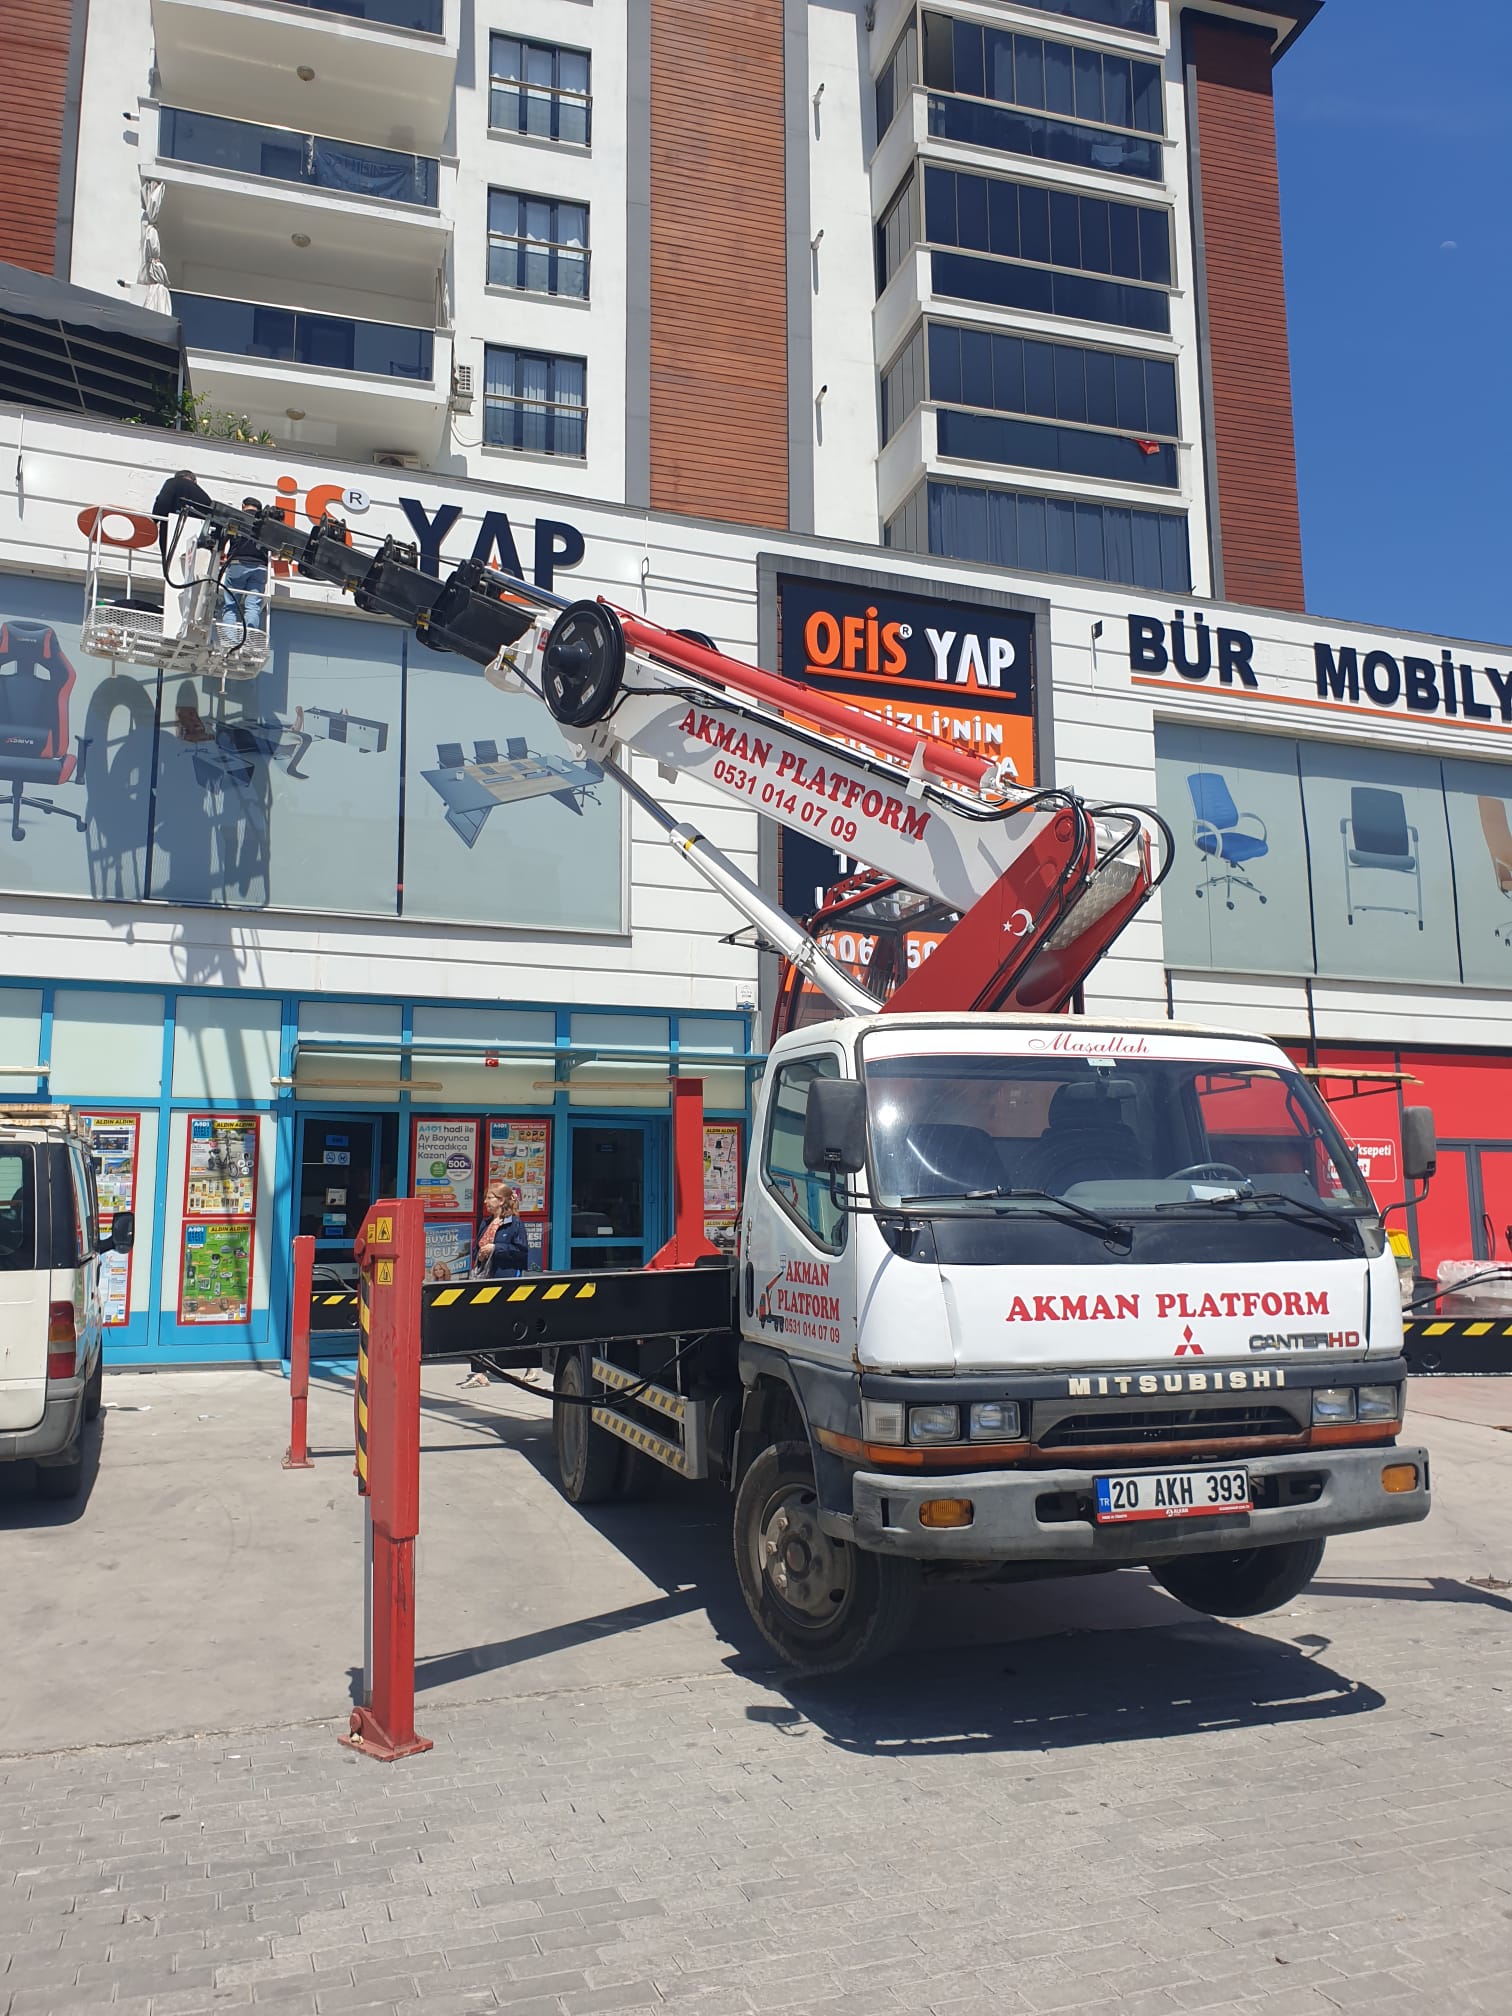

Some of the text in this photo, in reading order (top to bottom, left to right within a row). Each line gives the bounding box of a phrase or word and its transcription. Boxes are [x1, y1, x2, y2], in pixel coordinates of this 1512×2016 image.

[398, 496, 586, 595] YAP
[804, 606, 907, 675] OFİS
[923, 627, 1016, 688] YAP
[1128, 609, 1259, 688] BÜR
[678, 708, 773, 769] AKMAN
[775, 750, 932, 841] PLATFORM
[713, 759, 858, 843] 0531 014 07 09
[785, 1260, 830, 1287] AKMAN
[777, 1288, 841, 1321] PLATFORM
[1006, 1291, 1331, 1322] AKMAN PLATFORM
[784, 1318, 840, 1343] 0531 014 07 09
[1068, 1369, 1286, 1397] MITSUBISHI
[1112, 1473, 1246, 1509] 20 AKH 393
